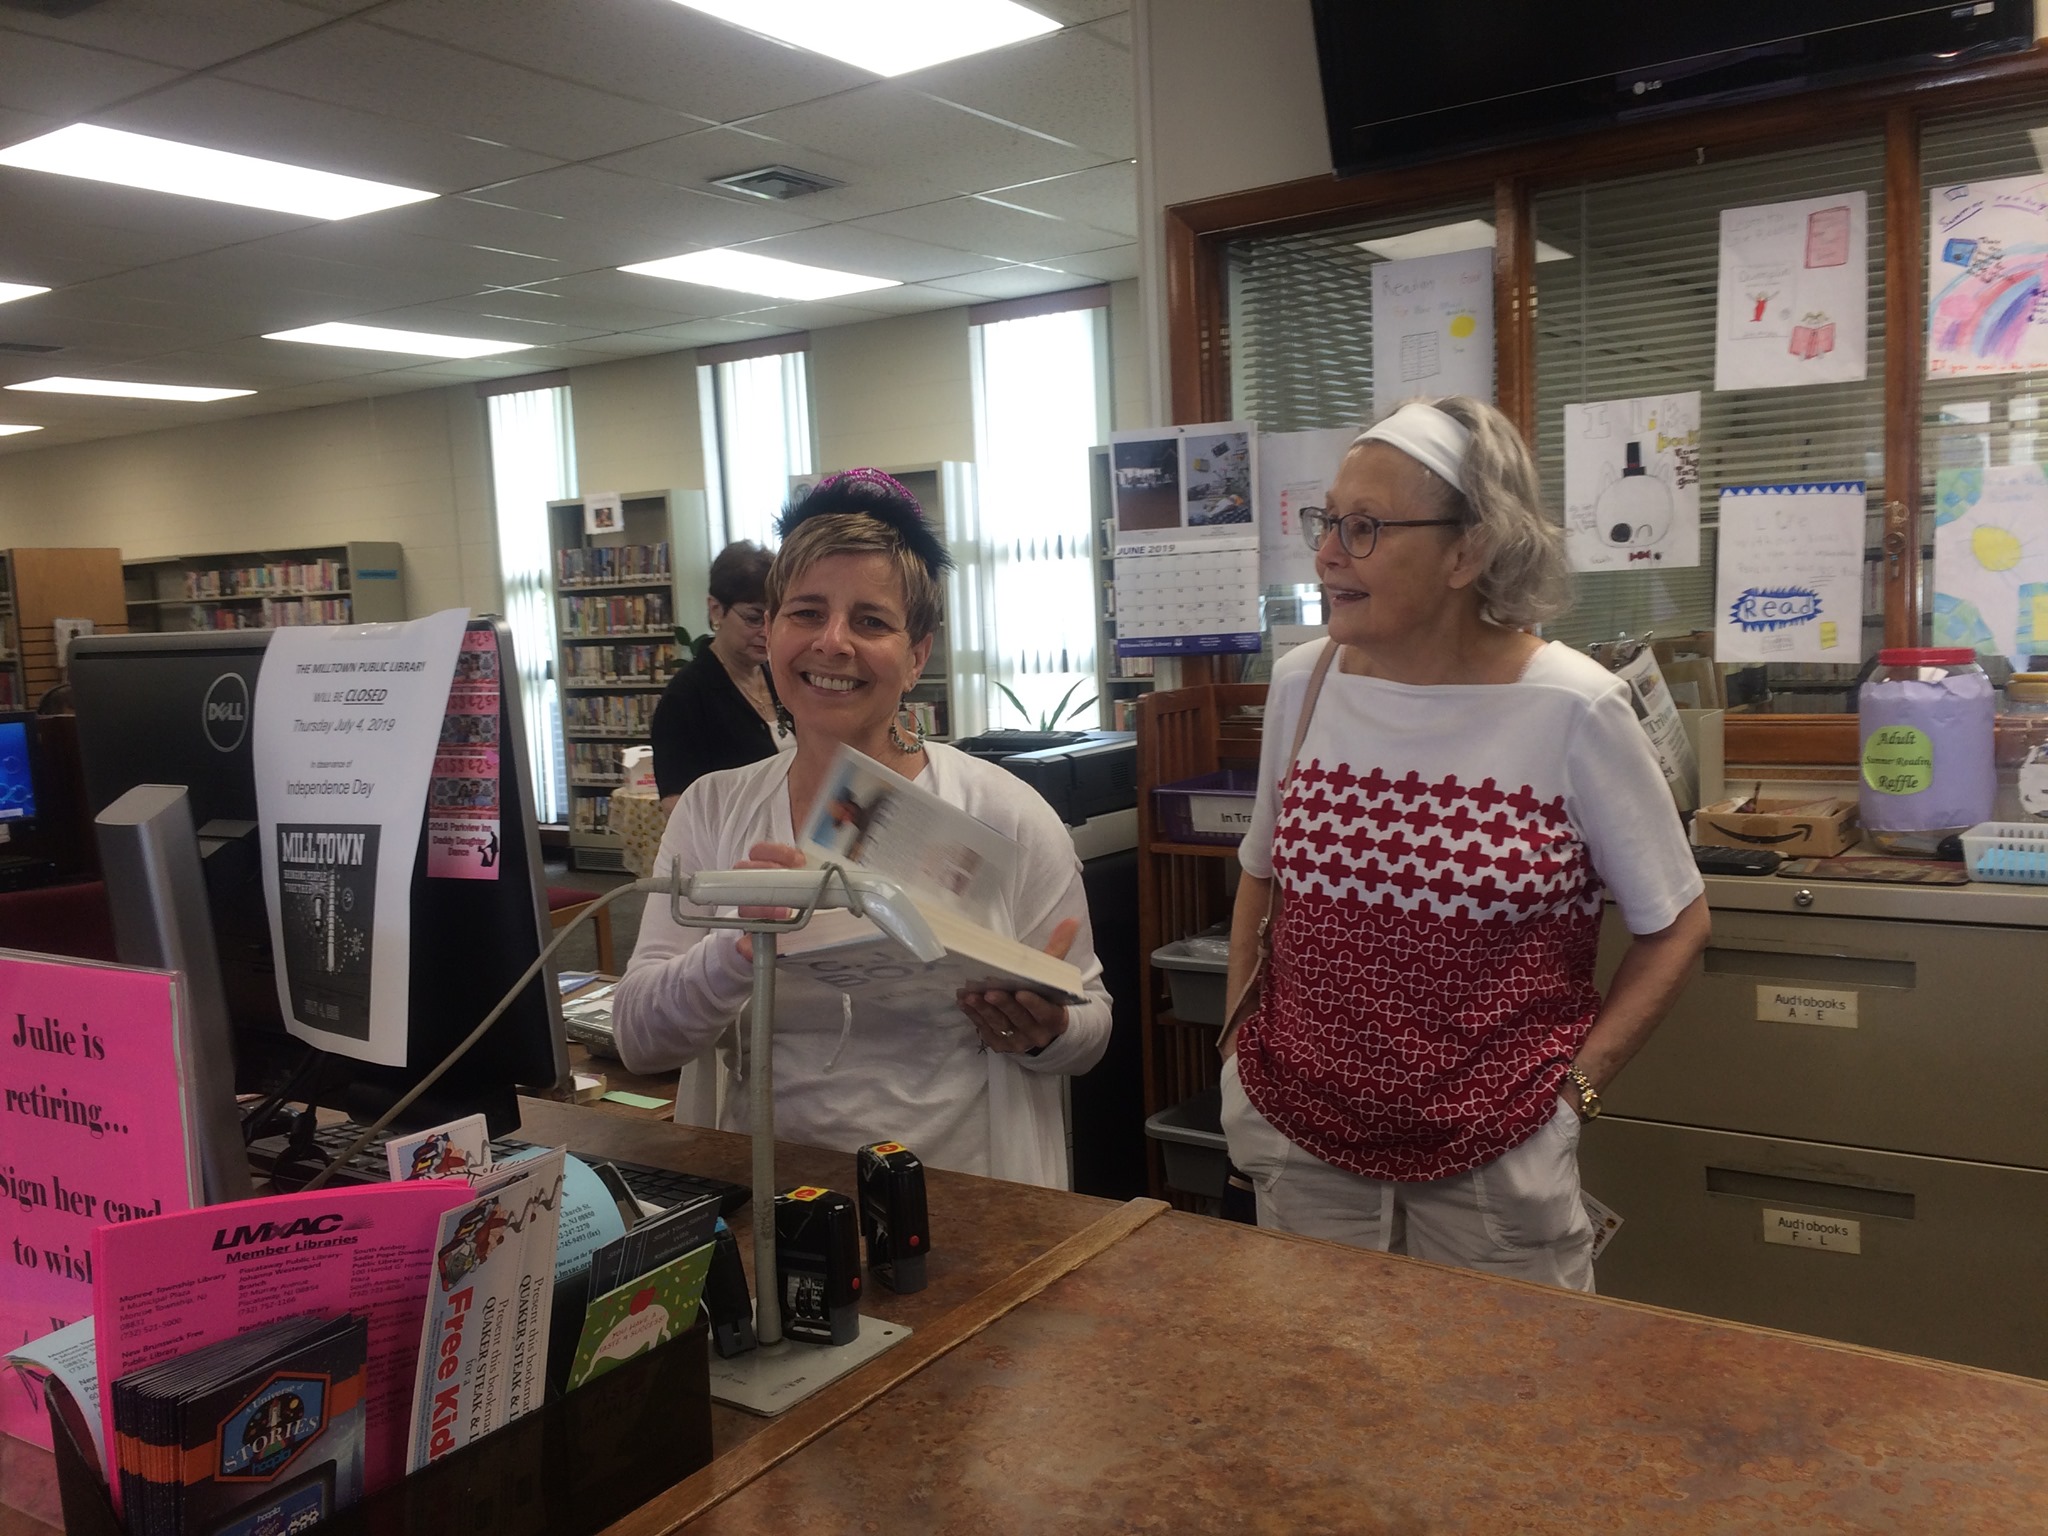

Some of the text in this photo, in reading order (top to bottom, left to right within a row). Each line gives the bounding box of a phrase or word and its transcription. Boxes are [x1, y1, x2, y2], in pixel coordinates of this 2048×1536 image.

[1117, 544, 1176, 556] JUNE 2019
[1744, 598, 1813, 619] Read
[296, 661, 426, 674] THE MILLTOWN PUBLIC LIBRARY
[333, 692, 344, 702] BE
[345, 689, 388, 703] CLOSED
[208, 702, 243, 721] DELL
[293, 719, 333, 734] Thursday
[334, 718, 355, 734] July
[367, 718, 396, 731] 2019
[1876, 731, 1917, 746] Adult
[286, 779, 375, 798] Independence Day
[1878, 775, 1919, 792] Raffle
[1221, 813, 1233, 823] In
[282, 832, 365, 865] MILLTOWN
[1775, 993, 1846, 1010] Audiobooks
[1789, 1007, 1797, 1018] A
[1817, 1010, 1824, 1020] E
[12, 1013, 106, 1061] Julie is
[51, 1175, 97, 1218] her
[1778, 1217, 1849, 1236] Audiobooks
[226, 1235, 358, 1264] Member Libraries
[1792, 1231, 1799, 1240] F
[1820, 1235, 1828, 1246] L
[12, 1236, 38, 1269] to
[285, 1256, 309, 1266] Public
[119, 1273, 226, 1303] Monroe Township Library
[518, 1274, 532, 1340] QUAKER
[530, 1277, 545, 1328] Present
[438, 1286, 474, 1381] Free
[478, 1297, 496, 1362] QUAKER
[494, 1298, 509, 1348] Present
[122, 1330, 204, 1360] New Brunswick Free
[528, 1330, 539, 1354] this
[122, 1347, 179, 1369] Public Library
[490, 1349, 503, 1373] this
[512, 1342, 525, 1394] STEAK
[463, 1358, 477, 1387] for a
[252, 1385, 295, 1408] Universe
[472, 1362, 487, 1415] STEAK
[510, 1395, 520, 1408] &
[470, 1418, 481, 1431] &
[224, 1416, 320, 1473] STORIES
